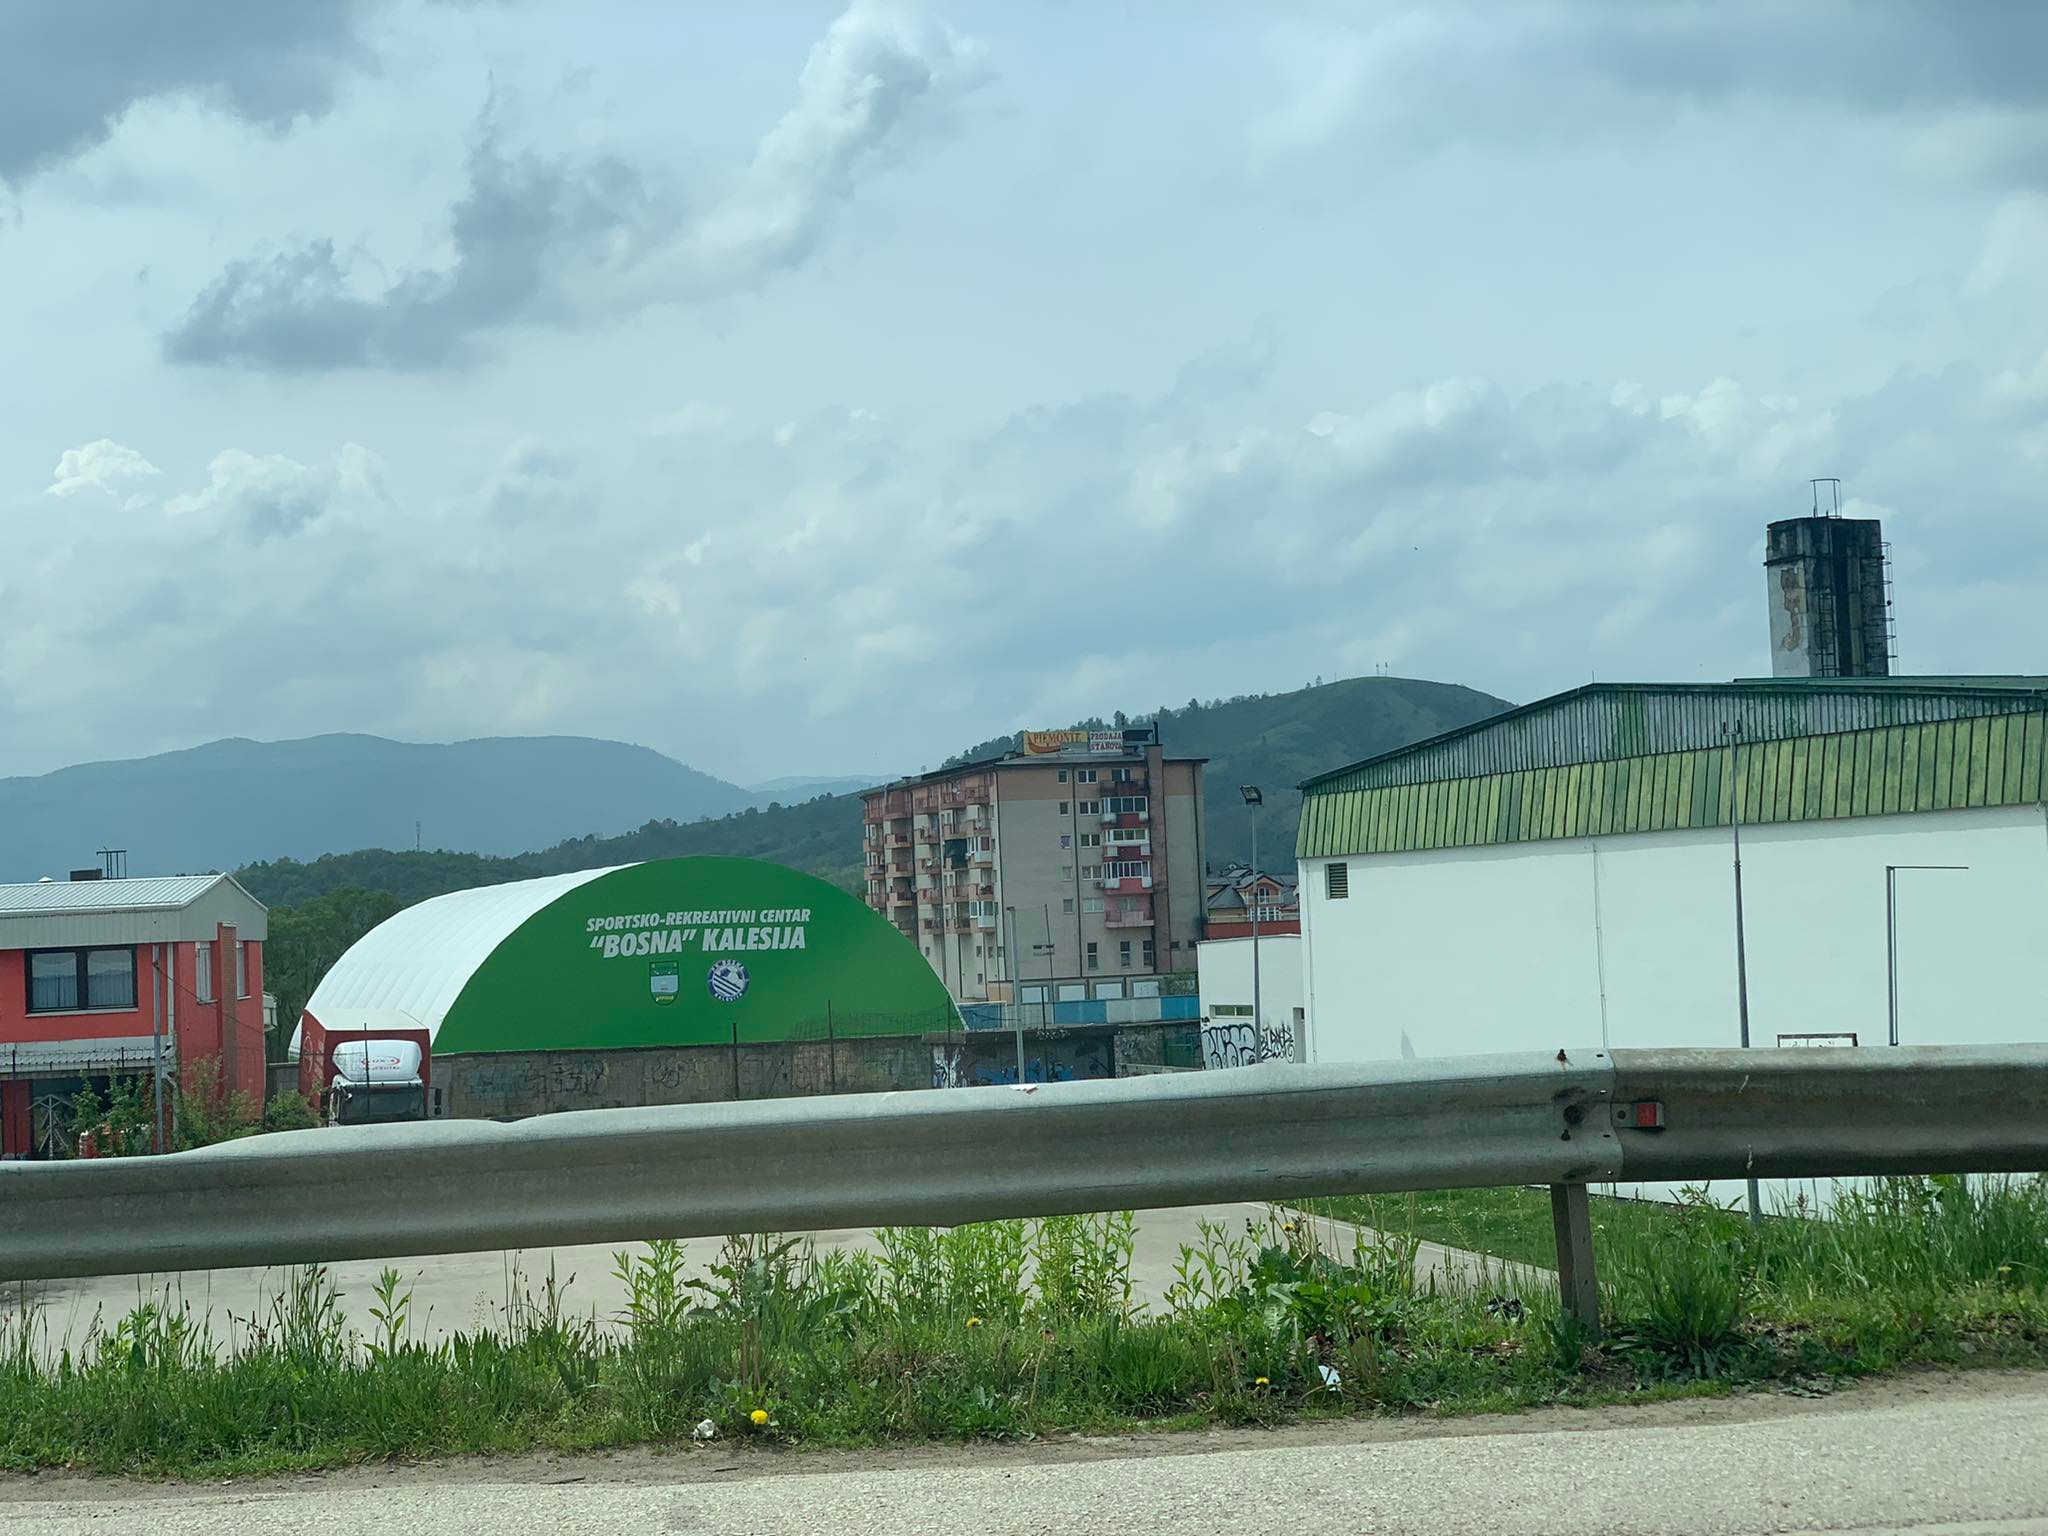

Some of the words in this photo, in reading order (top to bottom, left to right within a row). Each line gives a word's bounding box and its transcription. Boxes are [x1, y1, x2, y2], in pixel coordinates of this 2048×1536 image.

[1033, 732, 1082, 744] PIEMONTE
[1090, 732, 1122, 741] PRODAJA
[1090, 742, 1121, 751] STANOVA
[586, 910, 756, 932] SPORTSKO-REKREATIVNI
[759, 908, 811, 924] CENTAR
[589, 928, 697, 958] “BOSNA”
[702, 926, 806, 951] KALESIJA
